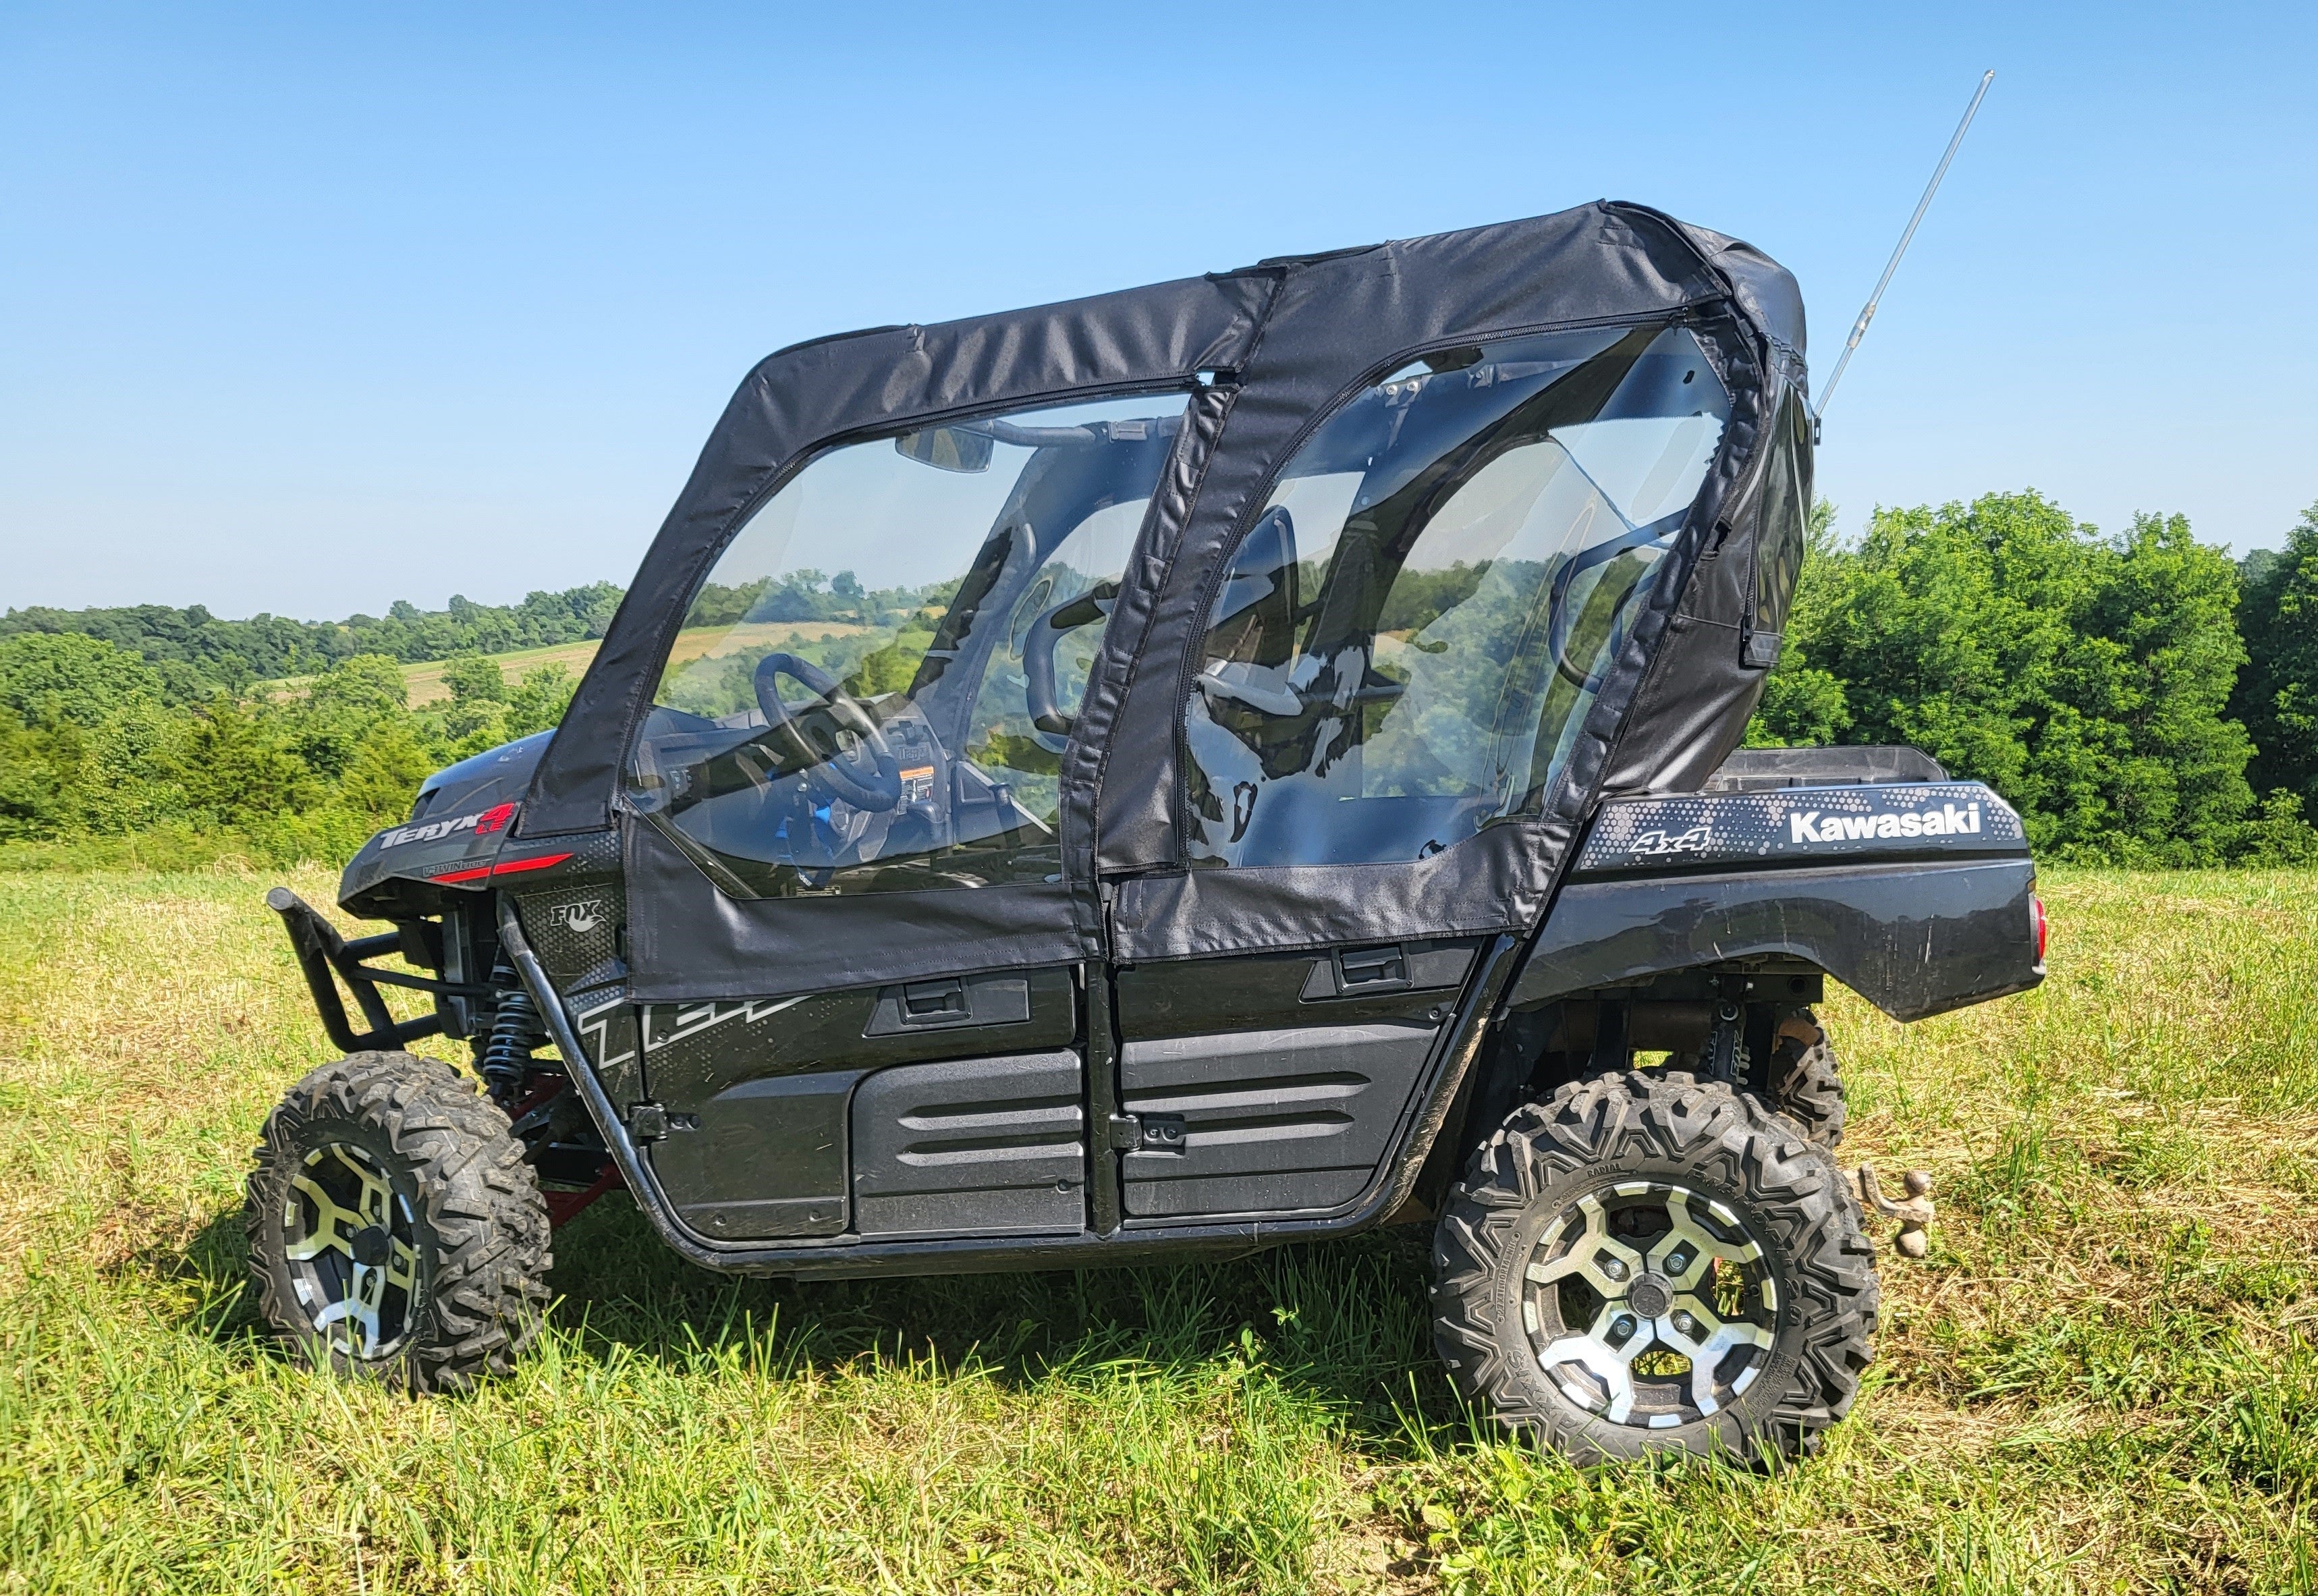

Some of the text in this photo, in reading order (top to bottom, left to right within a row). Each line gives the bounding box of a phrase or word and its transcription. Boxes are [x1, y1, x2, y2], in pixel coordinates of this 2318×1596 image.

[1790, 802, 1981, 844] Kawasaki
[1628, 826, 1713, 855] 4x4
[550, 900, 606, 933] FOX
[1586, 1163, 1622, 1178] RADIAL
